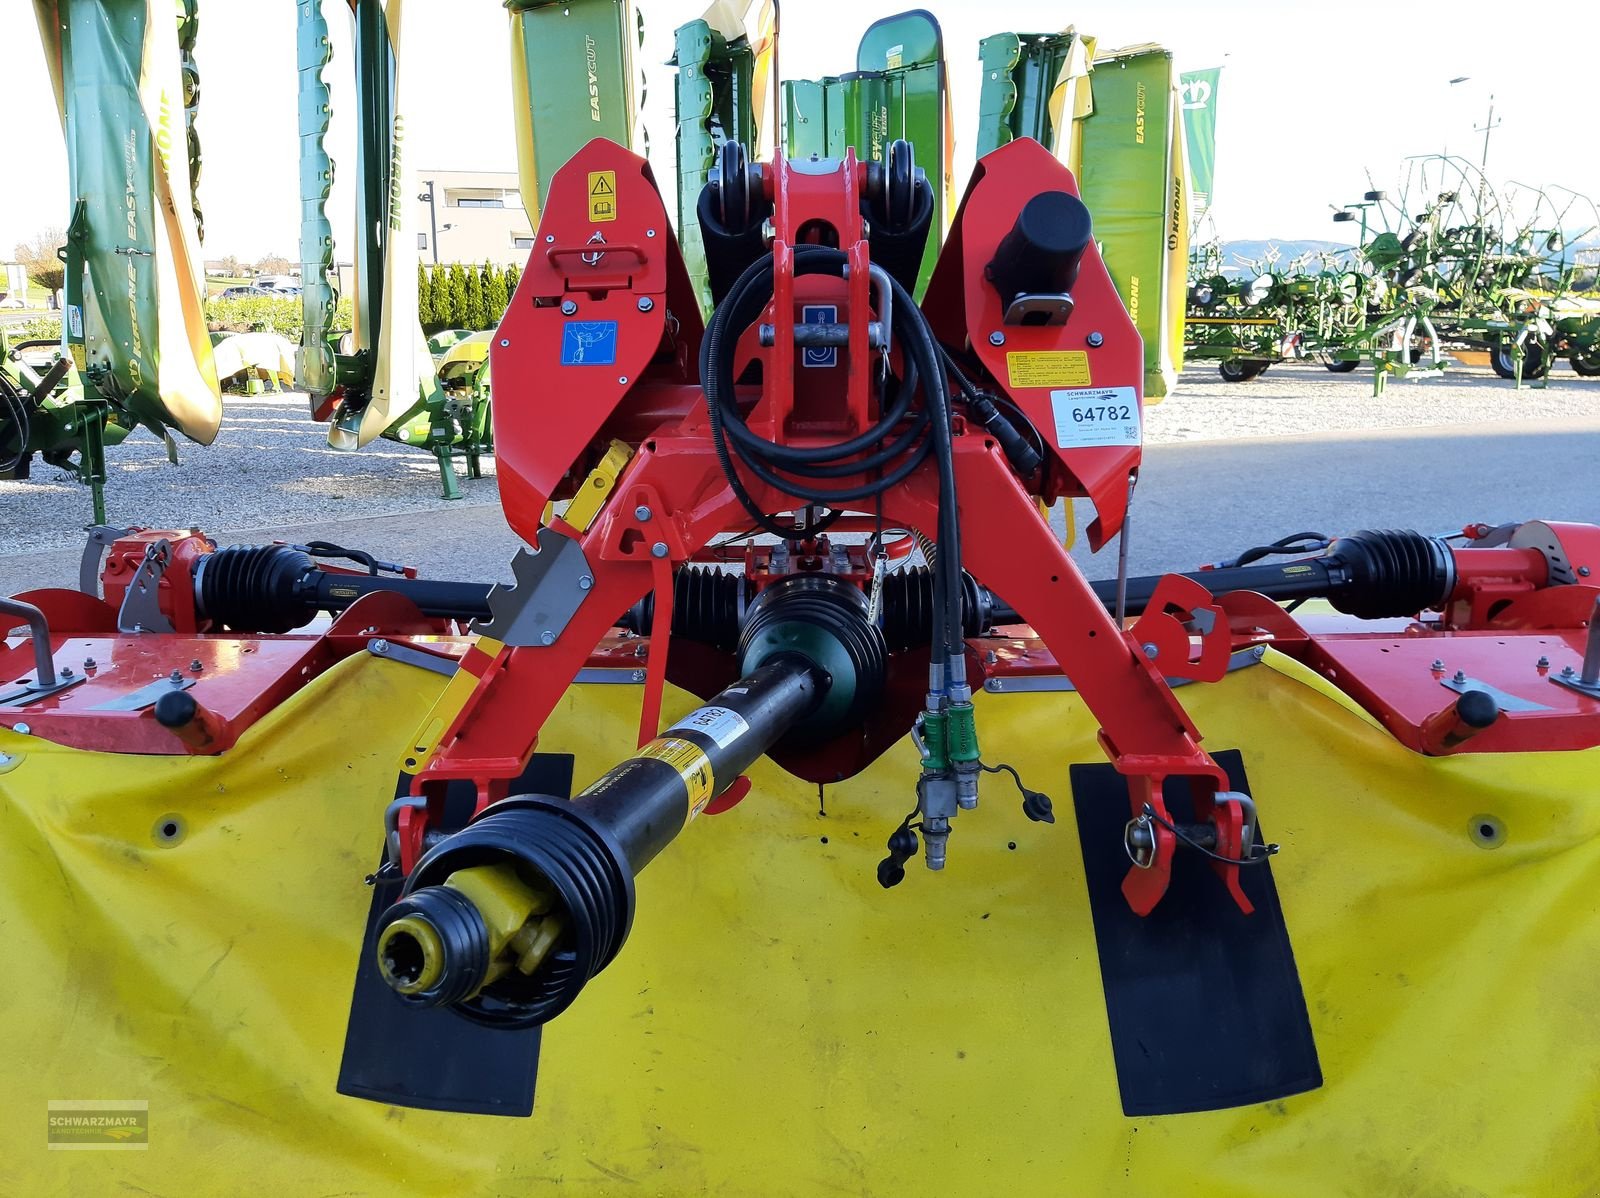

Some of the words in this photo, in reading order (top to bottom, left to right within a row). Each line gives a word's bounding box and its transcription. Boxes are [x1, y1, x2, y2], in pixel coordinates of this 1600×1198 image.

[586, 35, 600, 121] EASYCUT
[1135, 82, 1146, 144] EASYCUT
[390, 143, 402, 233] KRONE
[1172, 176, 1182, 233] KRONE
[127, 264, 142, 359] KRONE
[1072, 405, 1131, 423] 64782
[693, 708, 727, 726] 64782
